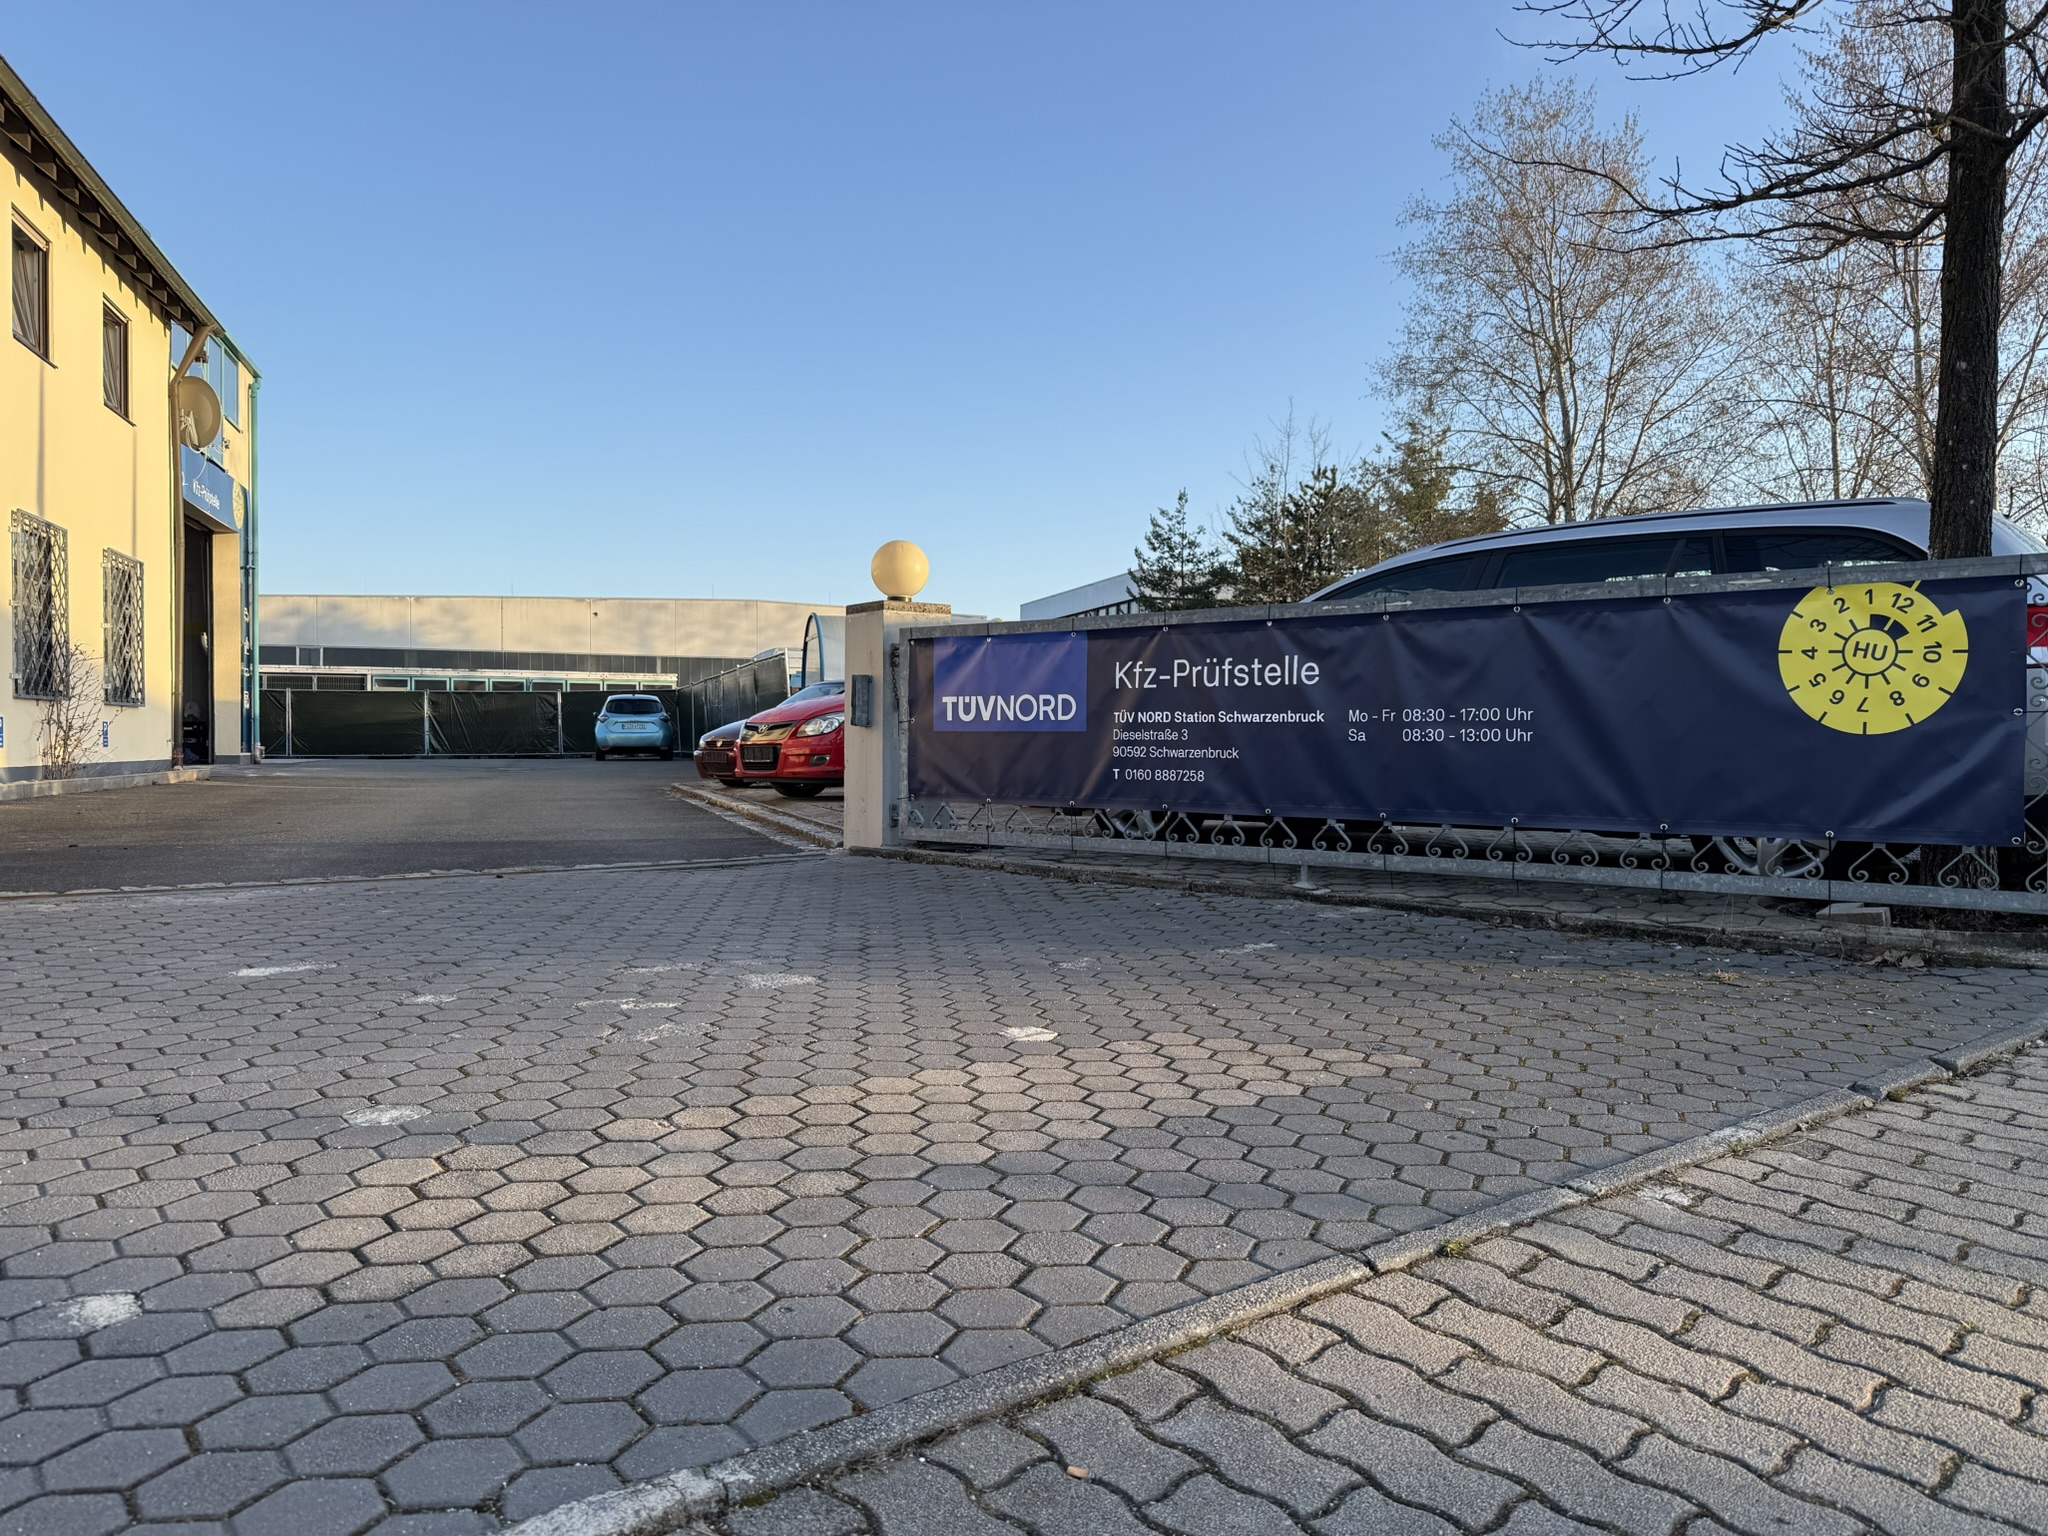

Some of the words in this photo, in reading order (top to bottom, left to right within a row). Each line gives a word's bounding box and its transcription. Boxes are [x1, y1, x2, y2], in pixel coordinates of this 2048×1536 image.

[1864, 589, 1873, 604] 1
[1891, 592, 1915, 614] 12
[1833, 597, 1850, 614] 2
[1810, 618, 1827, 633] 3
[1916, 614, 1938, 633] 11
[1801, 646, 1818, 660] 4
[1852, 640, 1889, 661] HU
[1922, 641, 1943, 664] 10
[1114, 655, 1321, 690] Kfz-Prüfstelle
[1808, 672, 1827, 688] 5
[1911, 673, 1930, 688] 9
[1829, 689, 1845, 705] 6
[1856, 697, 1870, 713] 7
[1889, 690, 1906, 707] 8
[1114, 709, 1135, 723] TÜV
[1138, 711, 1172, 723] NORD
[1174, 711, 1216, 723] Station
[1218, 710, 1325, 723] Schwarzenbruck
[1348, 709, 1369, 723] Mo
[1382, 708, 1396, 722] Fr
[1402, 708, 1445, 722] 08:30
[1459, 707, 1501, 721] 17:00
[1505, 707, 1534, 721] Uhr
[1113, 728, 1179, 741] Dieselstraße
[1181, 729, 1189, 741] 3
[1348, 728, 1367, 742] Sa
[1402, 728, 1445, 742] 08:30
[1459, 728, 1501, 742] 13:00
[1505, 728, 1534, 742] Uhr
[1112, 746, 1147, 758] 90592
[1149, 746, 1240, 759] Schwarzenbruck
[1113, 768, 1120, 780] T
[1125, 768, 1152, 781] 0160
[1154, 769, 1205, 782] 8887258
